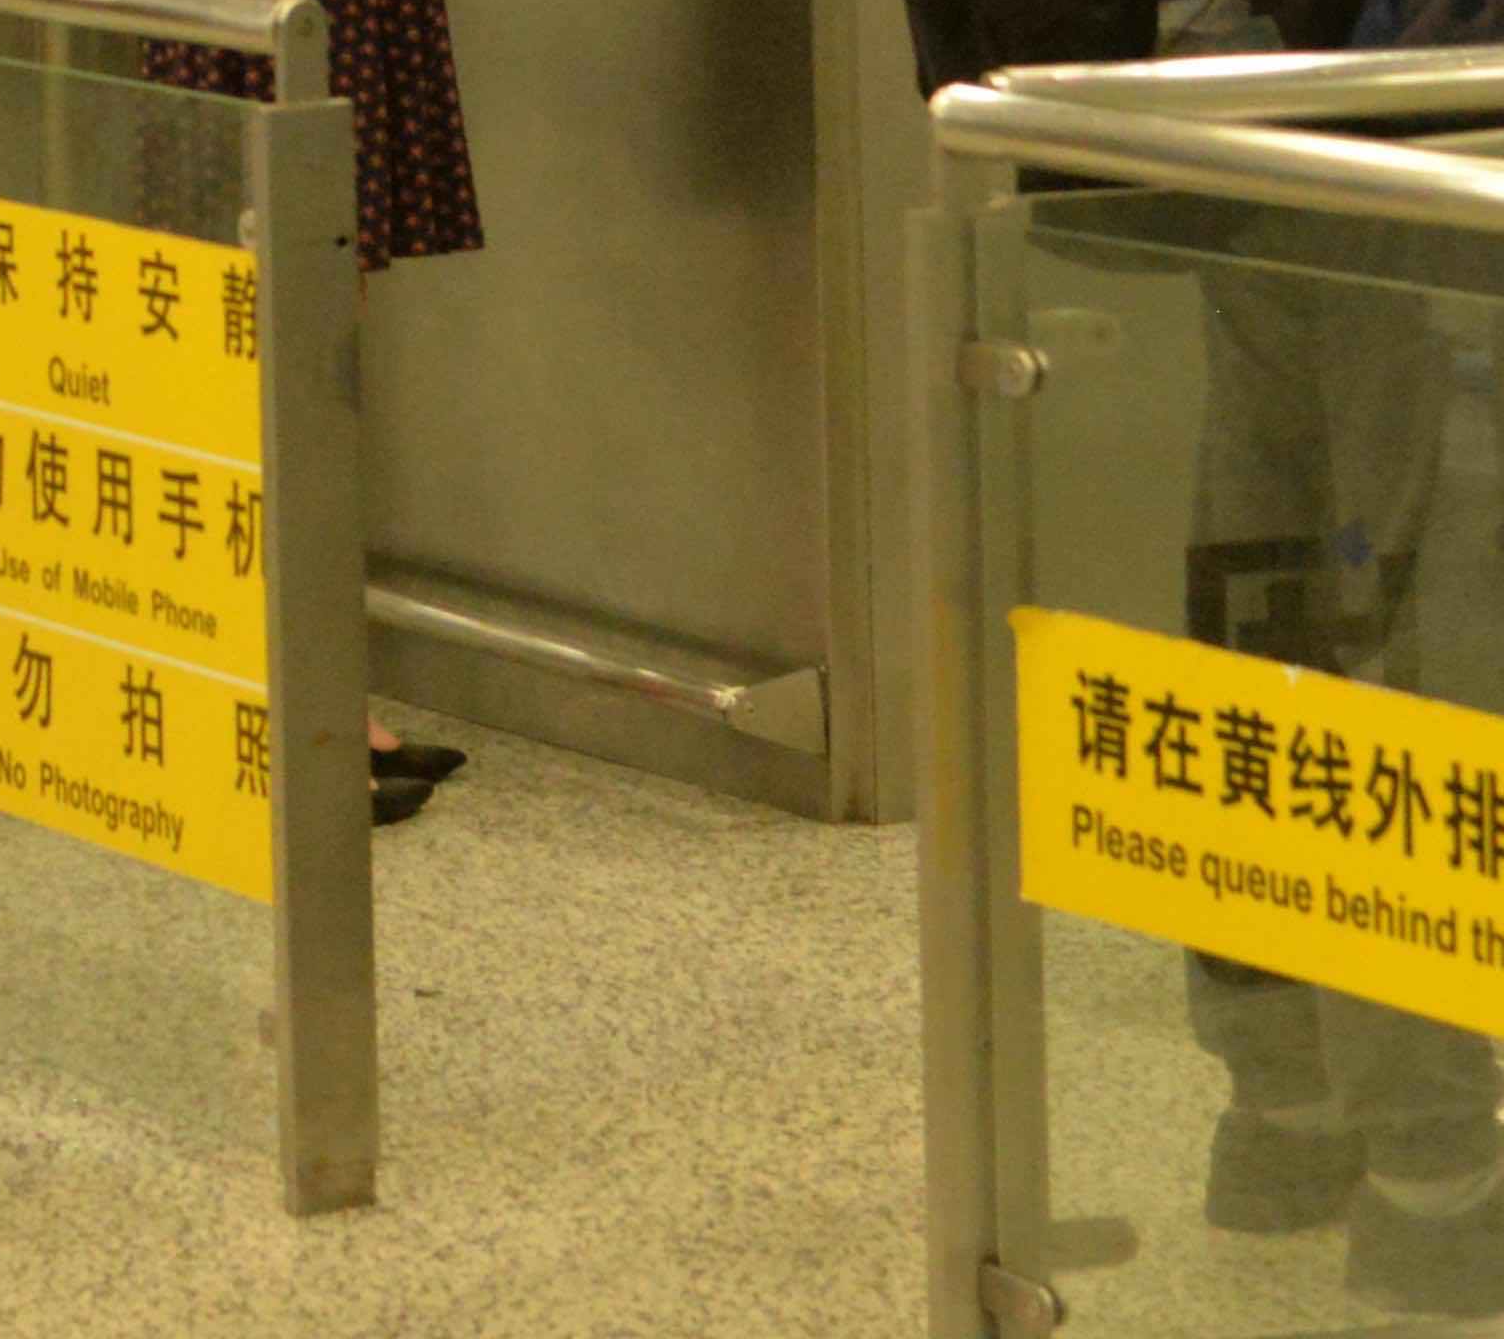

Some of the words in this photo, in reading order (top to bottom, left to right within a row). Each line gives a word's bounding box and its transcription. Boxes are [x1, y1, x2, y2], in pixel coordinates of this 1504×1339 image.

[48, 356, 111, 405] Quiet
[42, 558, 66, 594] of
[72, 566, 139, 616] Mobile
[151, 587, 217, 639] Phone
[39, 760, 185, 853] Photography
[1072, 803, 1188, 879] Please
[1199, 847, 1314, 915] queue
[1326, 873, 1459, 955] behind
